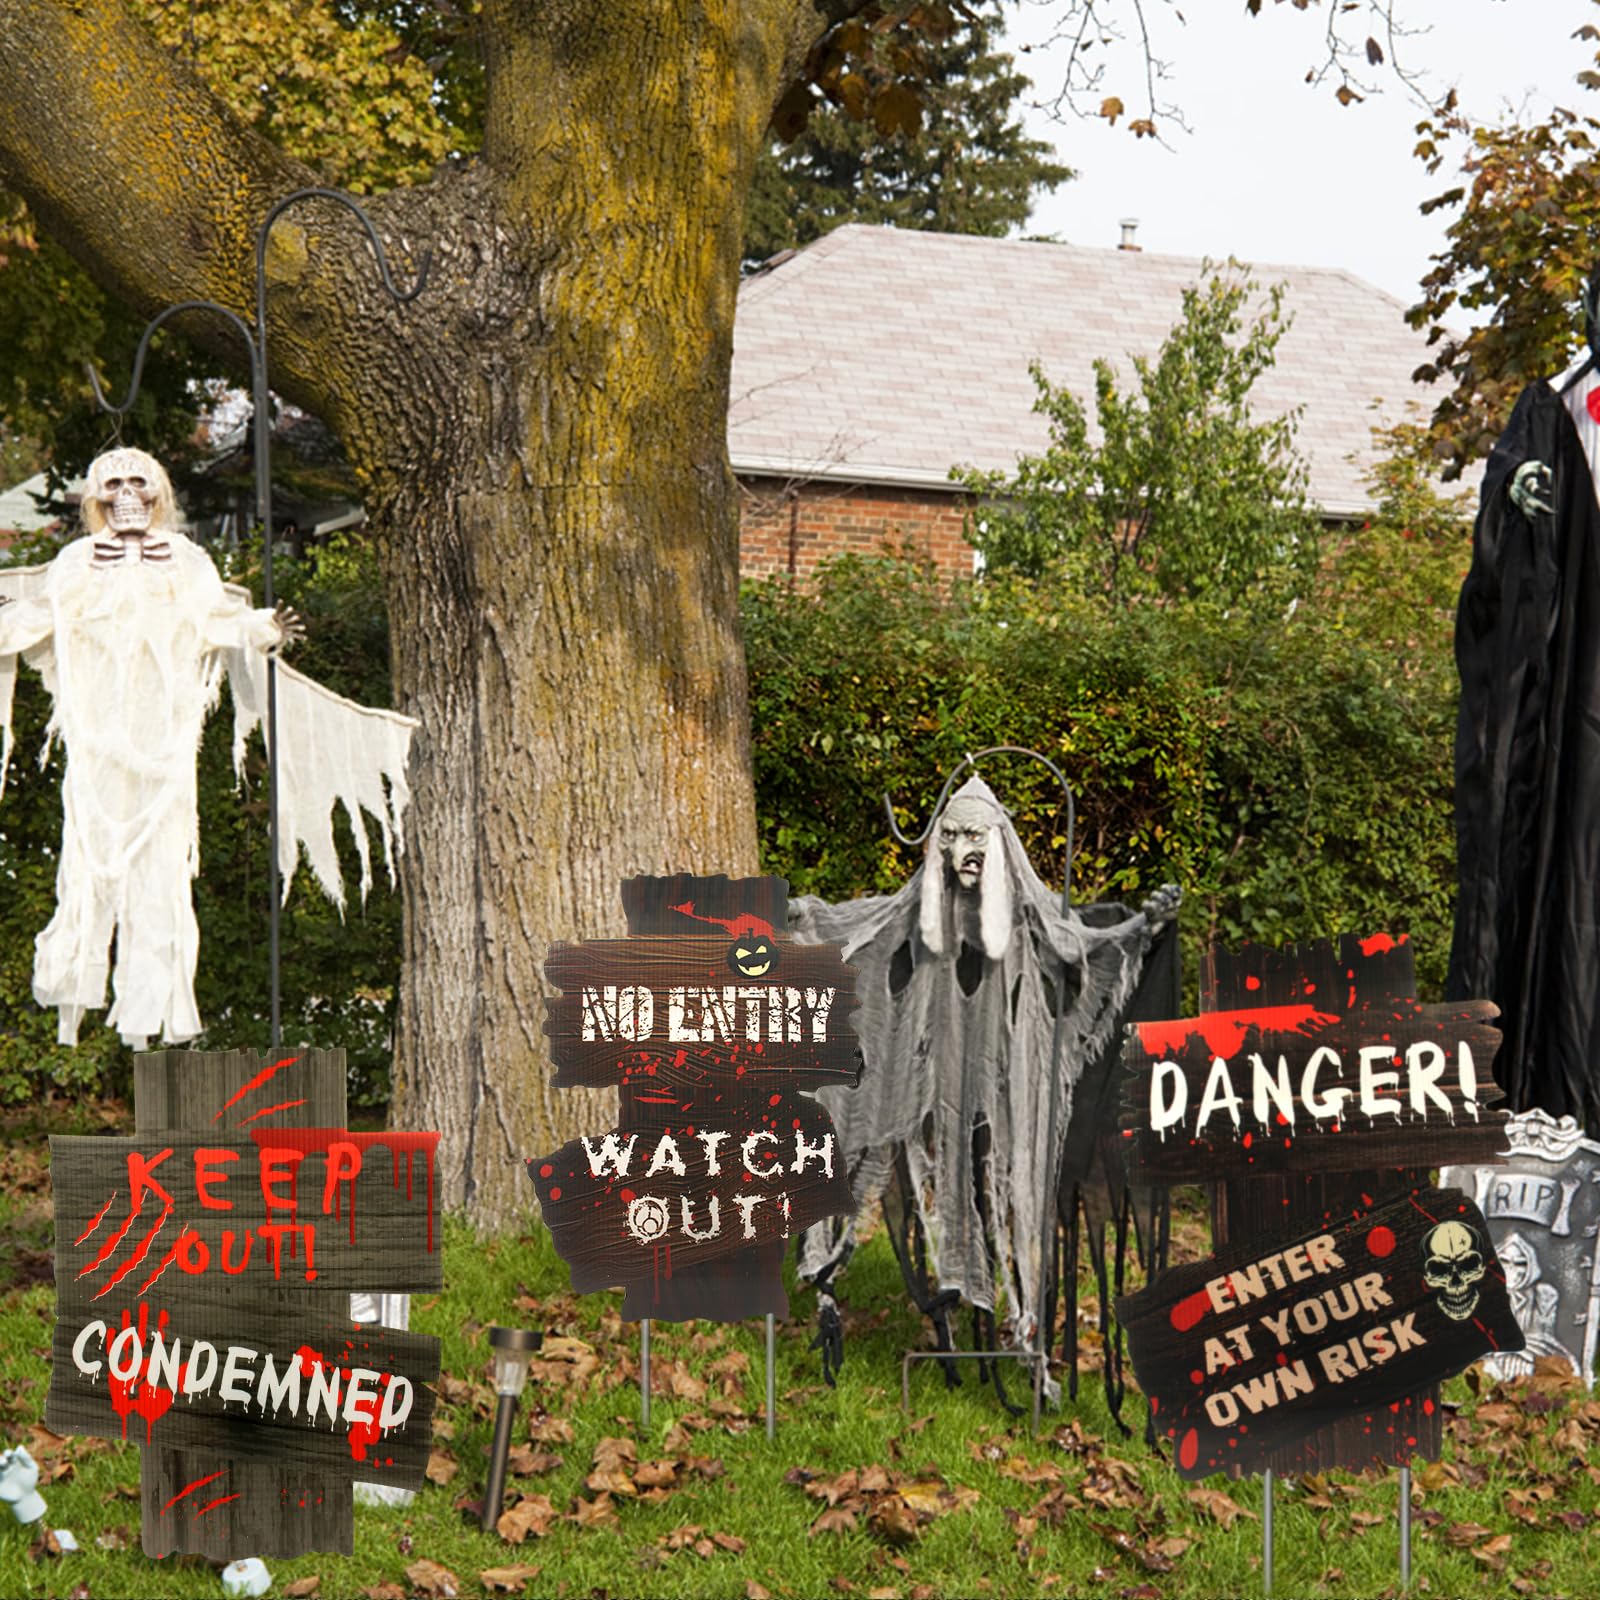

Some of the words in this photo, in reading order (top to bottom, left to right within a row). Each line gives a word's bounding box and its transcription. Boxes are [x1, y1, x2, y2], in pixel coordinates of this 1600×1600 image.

[582, 986, 653, 1042] NO
[669, 986, 836, 1042] ENTRY
[1149, 1041, 1479, 1141] DANGER!
[128, 1142, 361, 1215] KEEP
[581, 1130, 835, 1178] WATCH
[627, 1192, 790, 1243] OUT!
[1495, 1181, 1555, 1211] RIP
[176, 1223, 317, 1282] OUT!
[1205, 1234, 1346, 1315] ENTER
[1204, 1321, 1255, 1375] AT
[1260, 1272, 1392, 1345] YOUR
[72, 1320, 413, 1436] CONDEMNED
[1205, 1362, 1314, 1427] OWN
[1318, 1311, 1427, 1384] RISK
